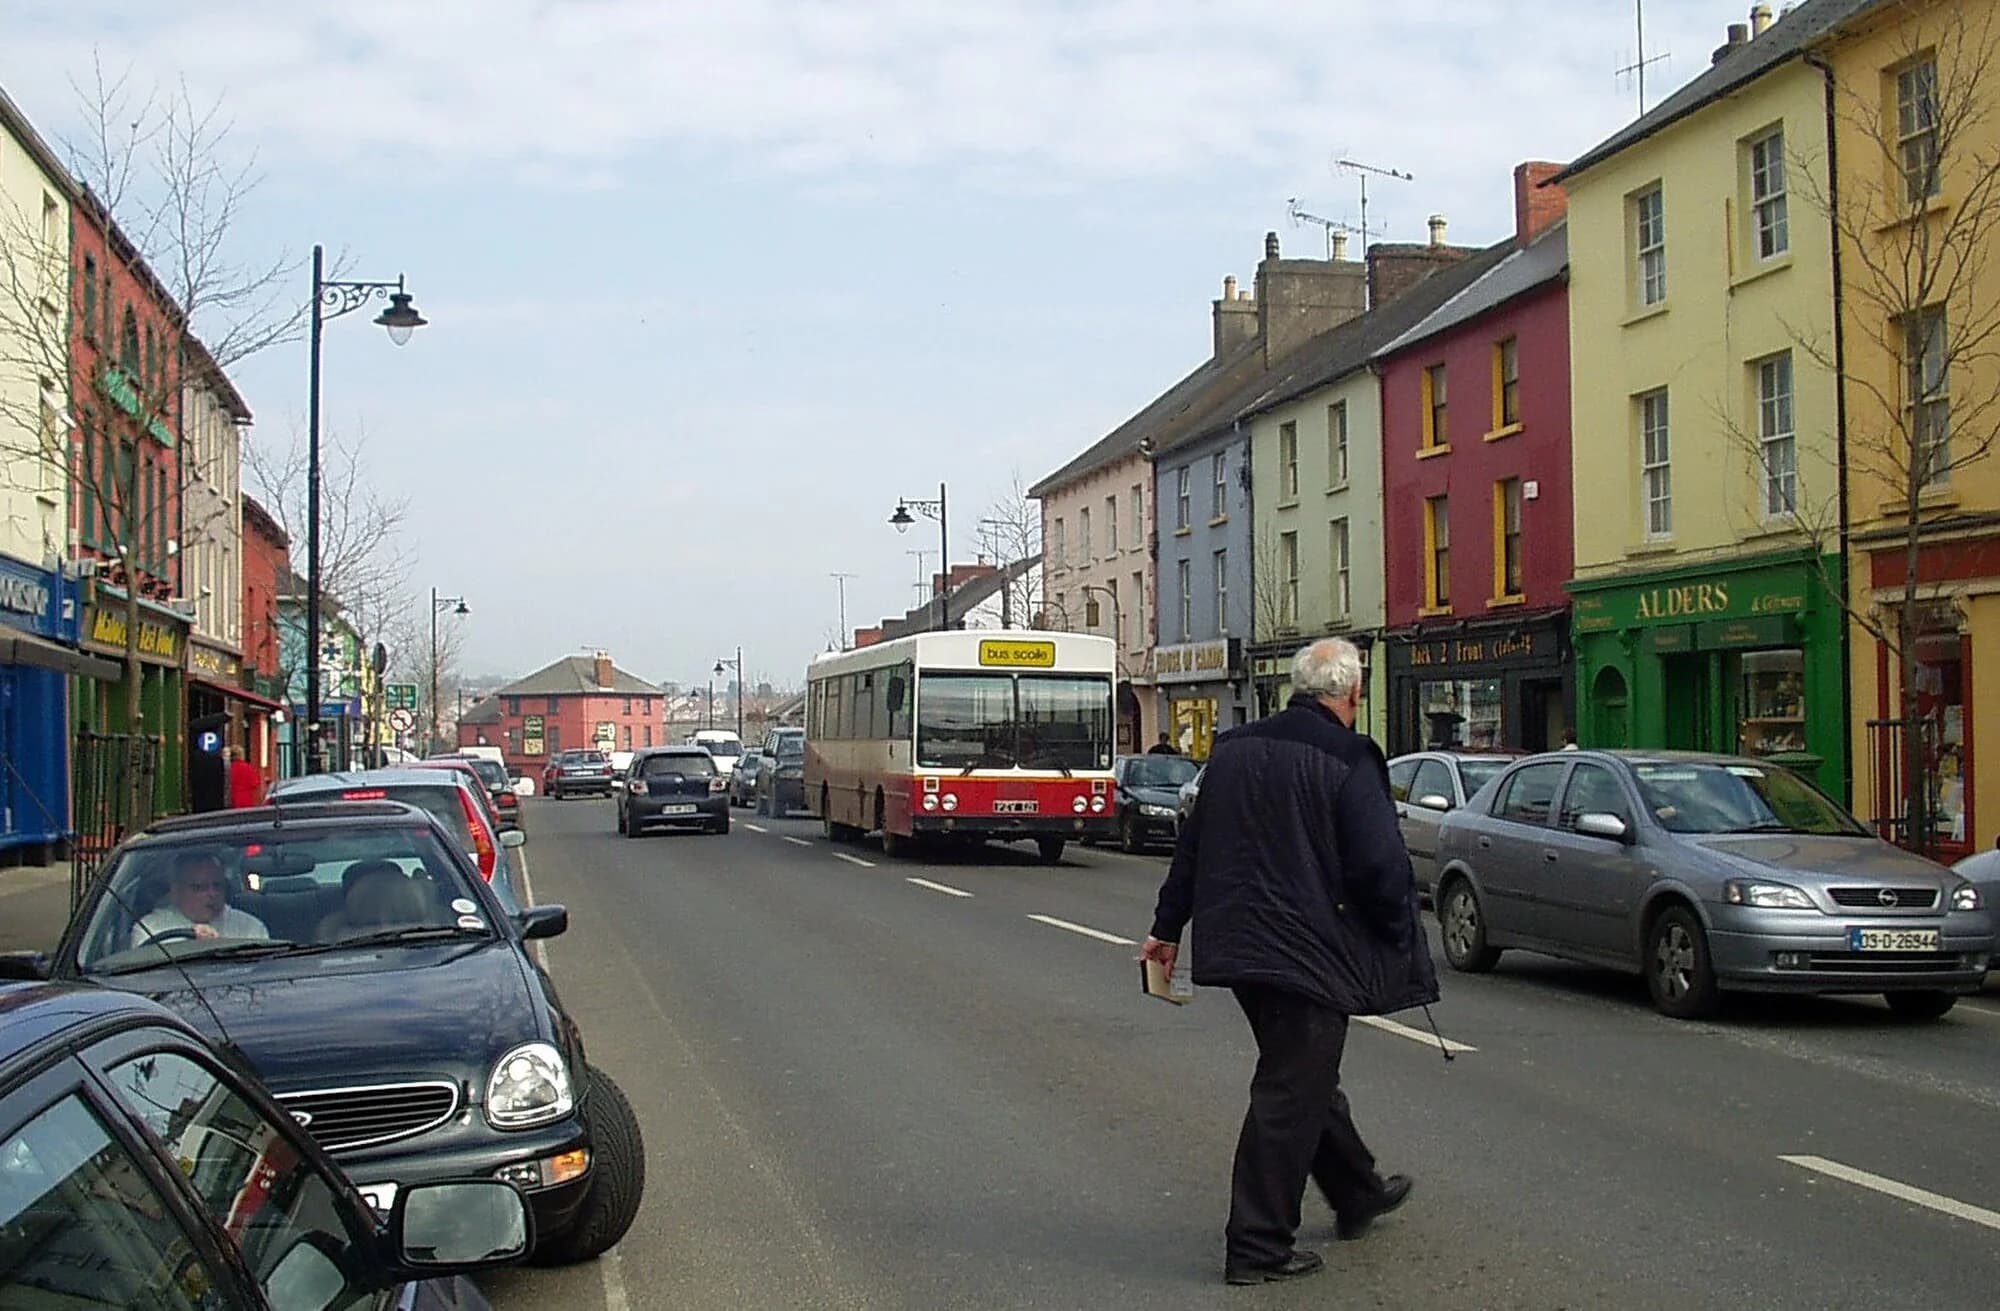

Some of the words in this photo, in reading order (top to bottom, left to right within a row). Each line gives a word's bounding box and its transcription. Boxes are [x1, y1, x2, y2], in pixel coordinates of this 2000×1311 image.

[1635, 583, 1729, 619] ALDERS
[987, 647, 1010, 660] bus
[1441, 641, 1449, 664] 2
[203, 731, 218, 751] P
